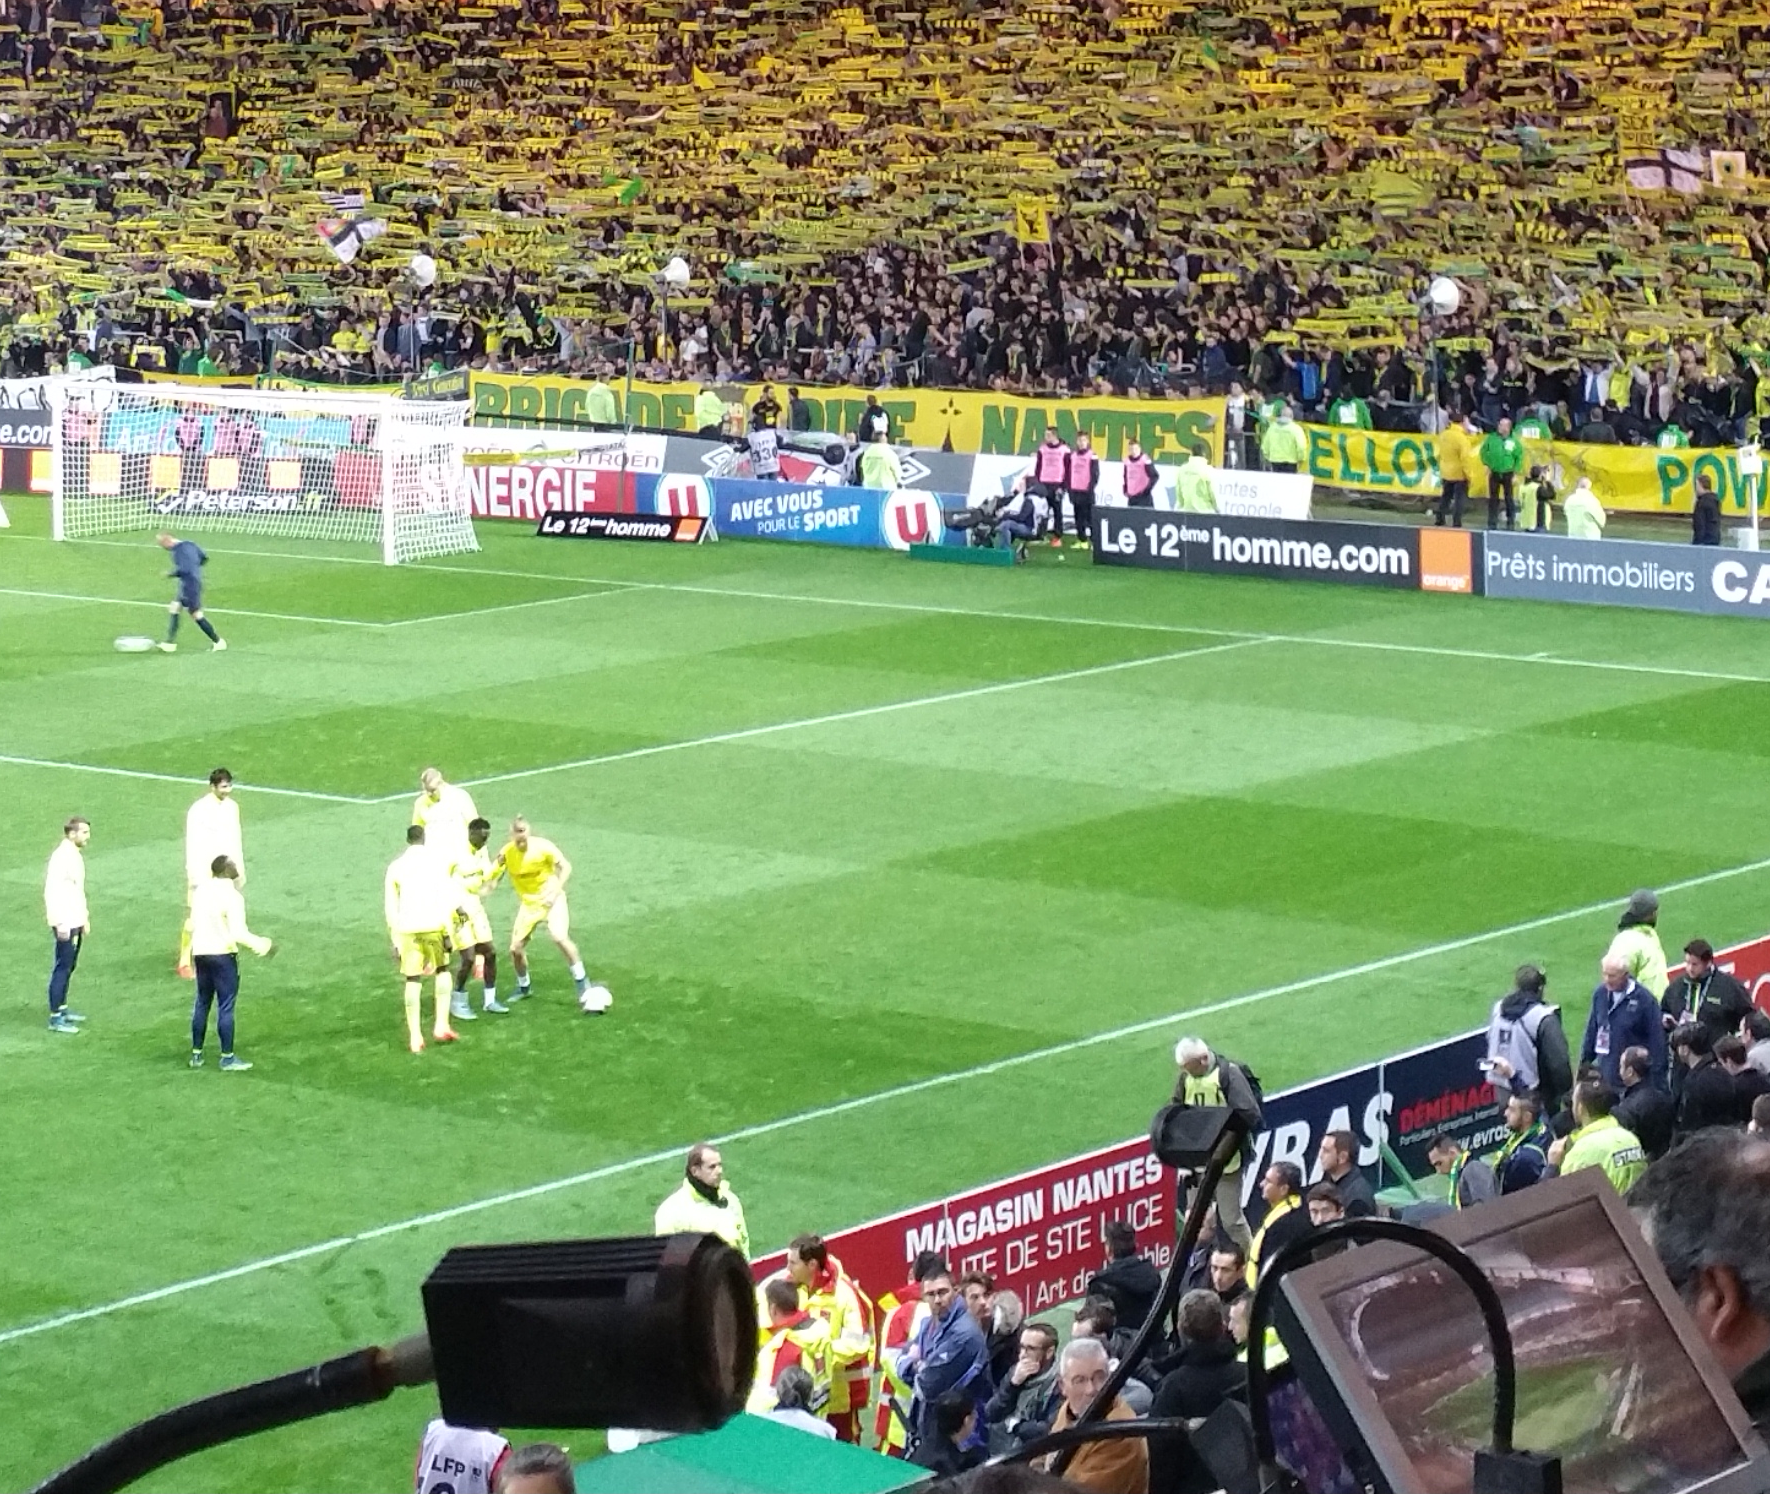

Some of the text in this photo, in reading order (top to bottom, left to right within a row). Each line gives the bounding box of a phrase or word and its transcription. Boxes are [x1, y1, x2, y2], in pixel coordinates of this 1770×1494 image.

[980, 404, 1215, 465] NANTES
[730, 488, 823, 522] AVEC VOUS
[757, 505, 861, 535] POUR LE SPORT
[895, 502, 930, 544] U
[542, 516, 564, 533] Le
[606, 519, 672, 538] homme
[1100, 518, 1137, 554] Le
[1212, 526, 1410, 577] homme.com
[1422, 574, 1466, 591] orange
[1487, 550, 1546, 583] Prêts
[1551, 554, 1696, 594] immobiliers
[905, 1154, 1163, 1264] MAGASIN NANTES
[1005, 1233, 1039, 1276] DE
[1045, 1215, 1092, 1261] STE
[1035, 1277, 1067, 1309] Art
[430, 1454, 466, 1478] LFP
